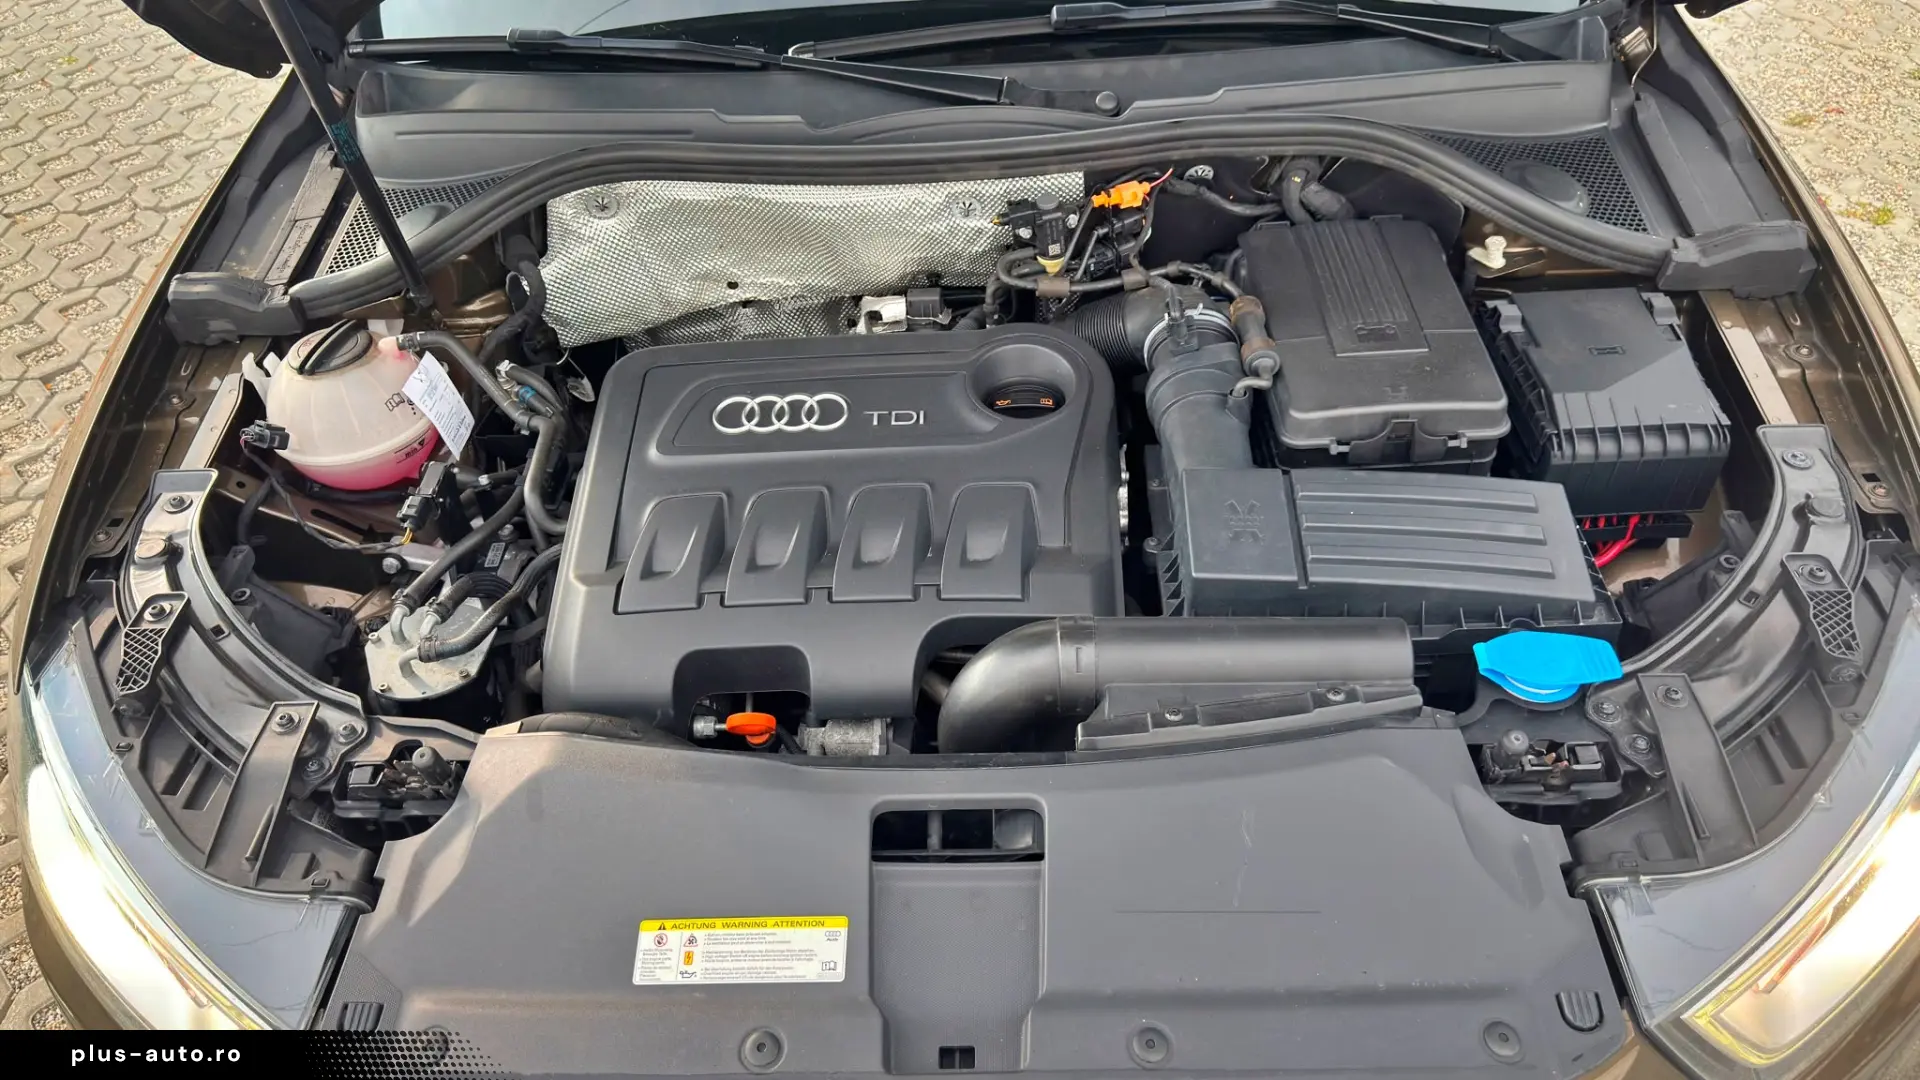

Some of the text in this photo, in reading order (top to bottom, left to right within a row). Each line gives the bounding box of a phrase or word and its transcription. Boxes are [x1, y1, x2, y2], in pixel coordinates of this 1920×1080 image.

[863, 410, 925, 426] TDI
[405, 447, 419, 458] min
[671, 920, 825, 930] ACHTUNG WARNING ATTENTION
